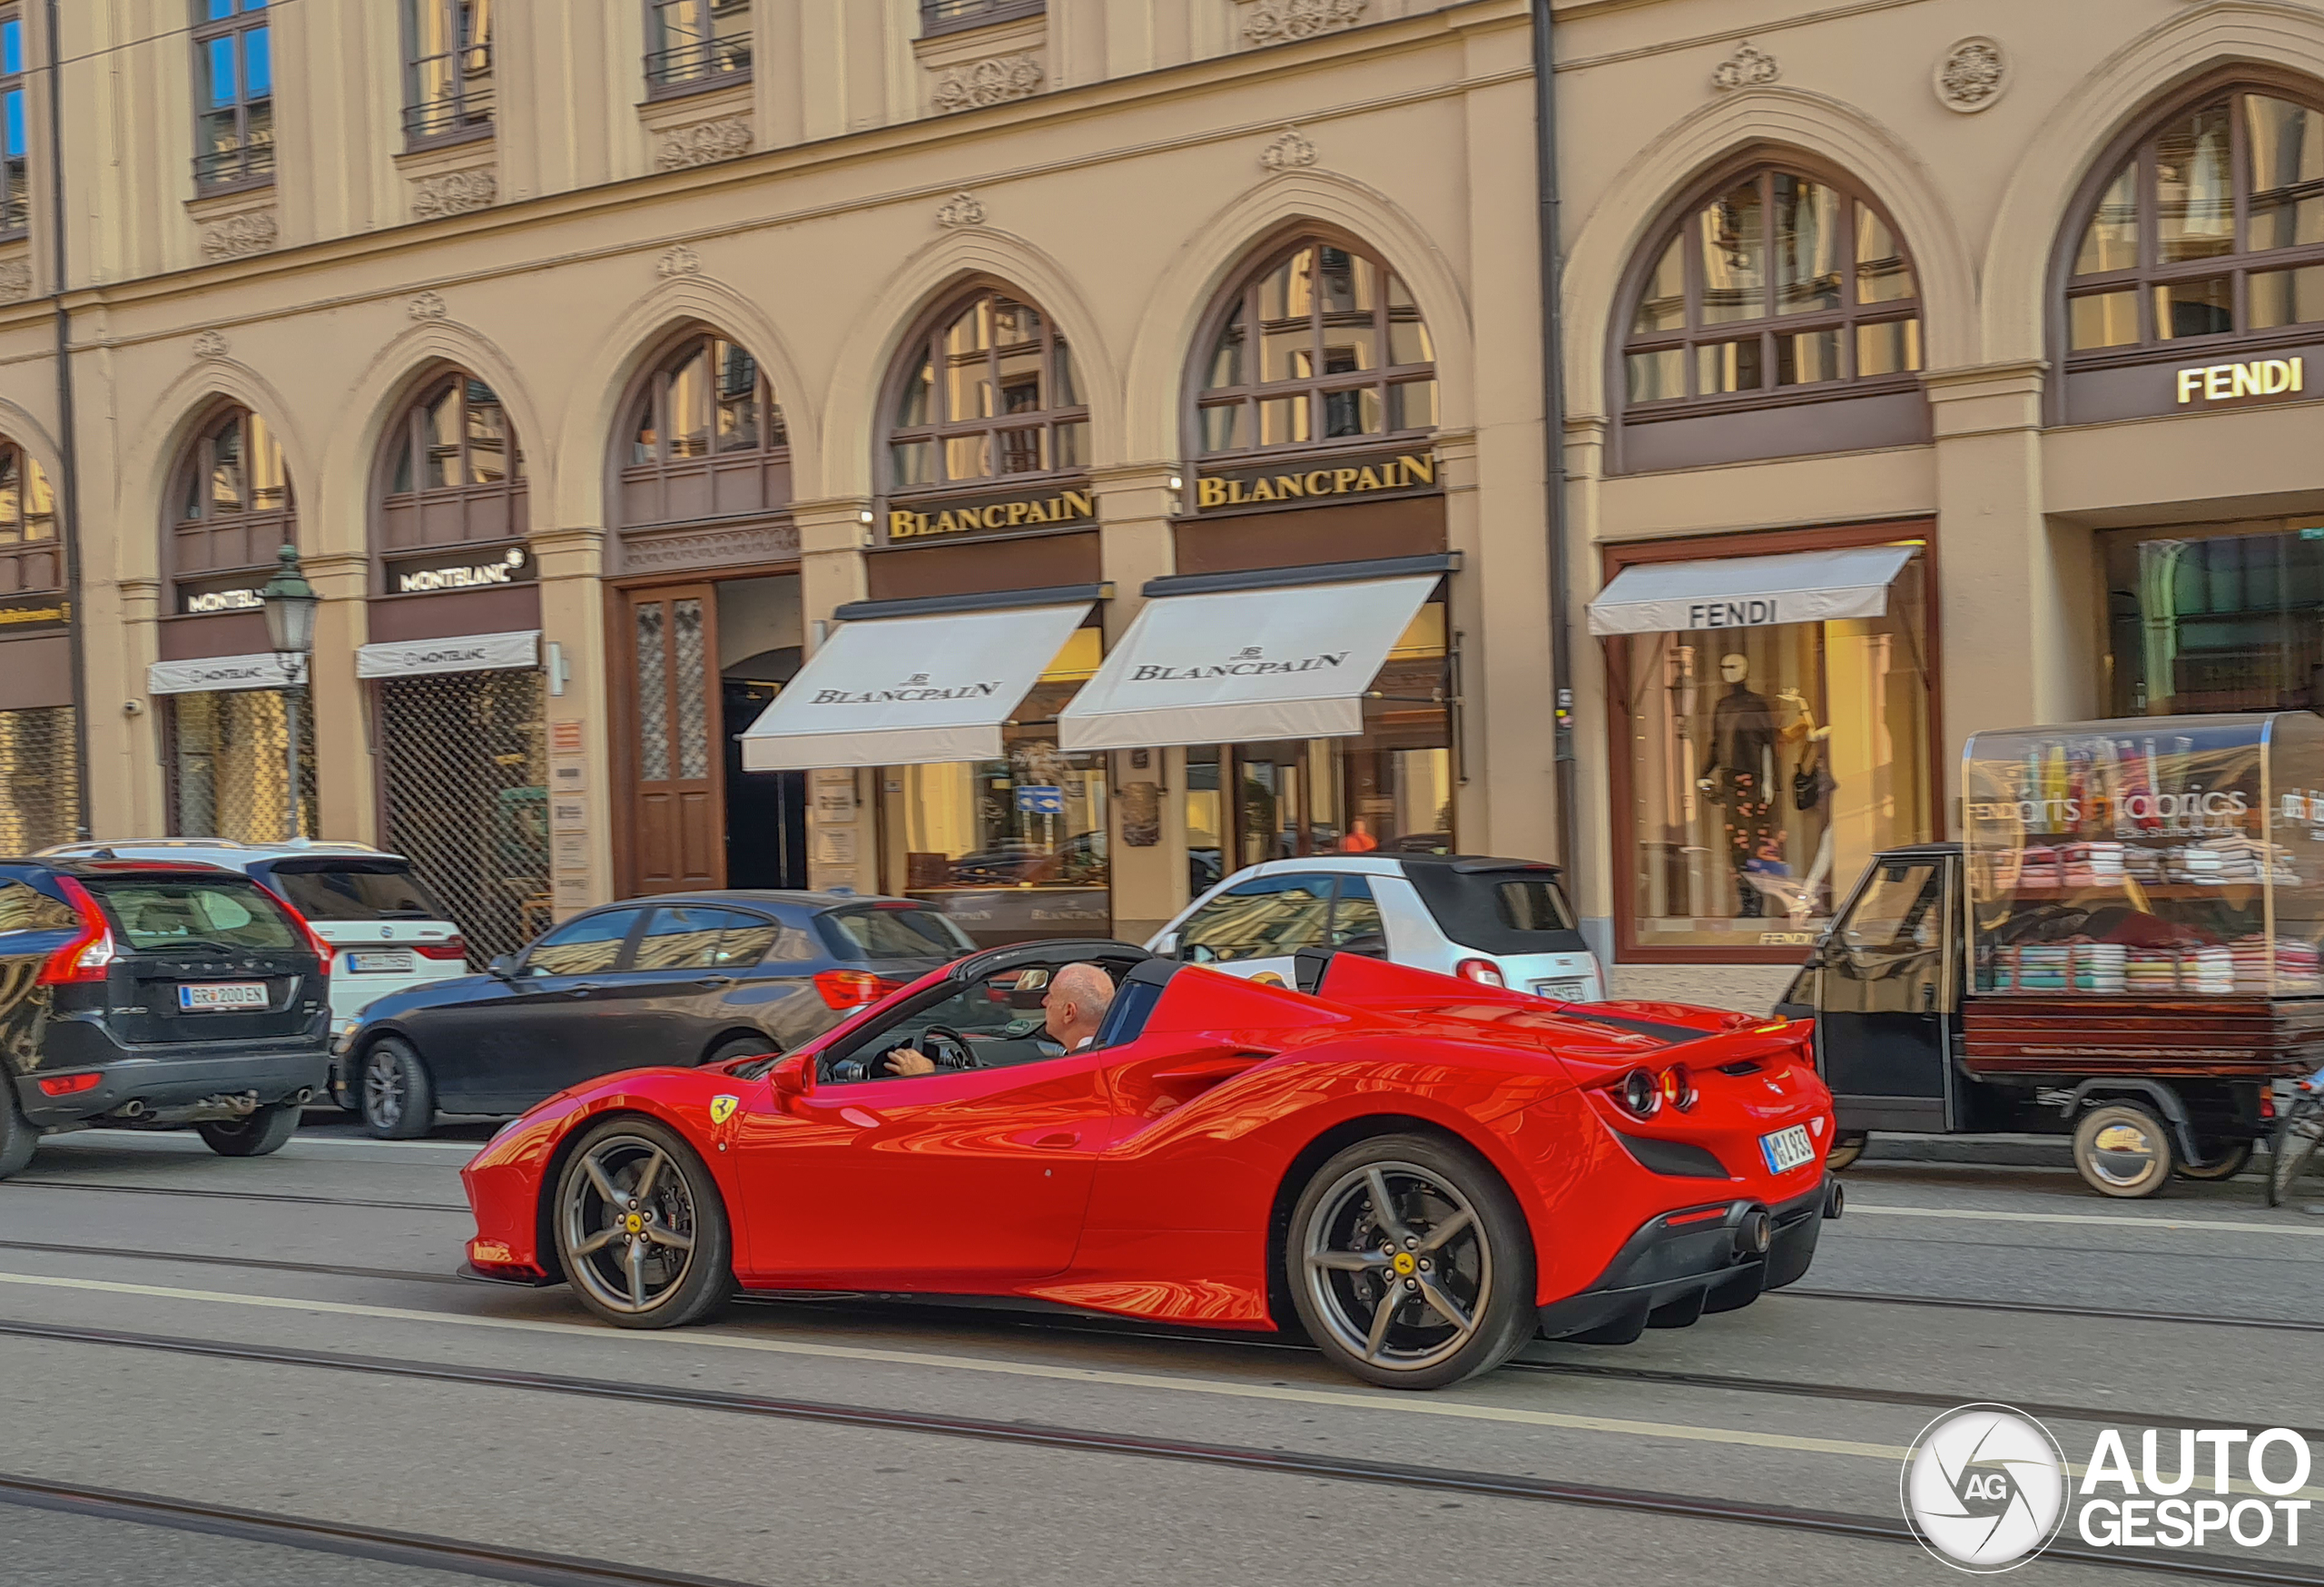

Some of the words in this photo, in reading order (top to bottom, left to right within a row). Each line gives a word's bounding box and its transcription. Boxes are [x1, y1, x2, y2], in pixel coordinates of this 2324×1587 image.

[2177, 357, 2303, 403] FENDI
[1196, 453, 1434, 508] BLANCPAIN
[889, 488, 1093, 538] BLANCPAIN
[399, 562, 511, 592] MONTBLANC
[1689, 599, 1777, 627] FENDI
[1129, 651, 1351, 681] BLANCPAIN
[807, 681, 1003, 705] BLANCPAIN
